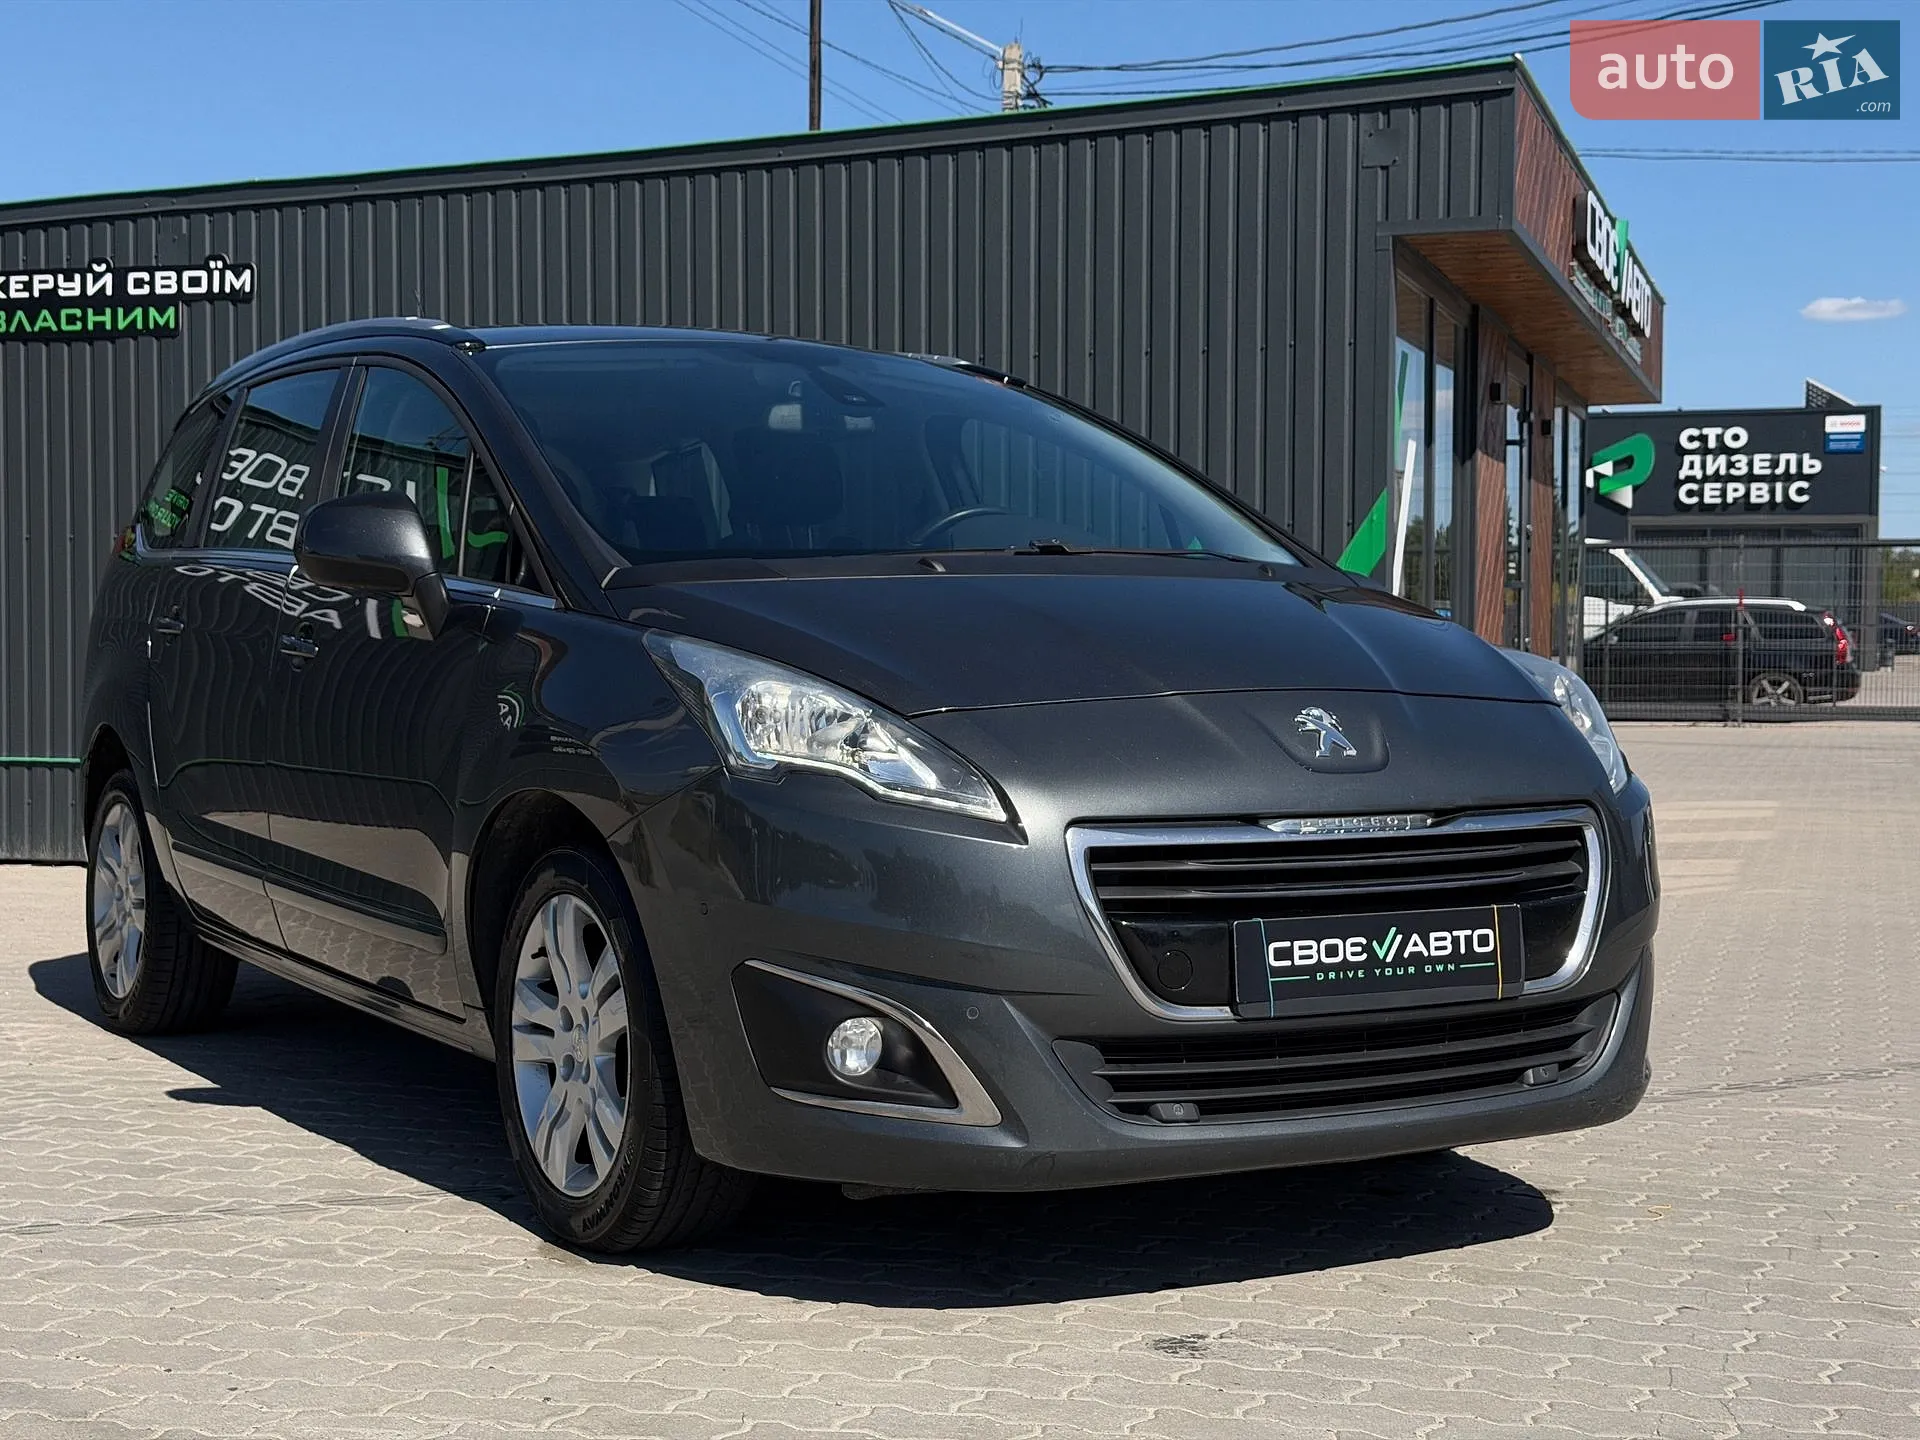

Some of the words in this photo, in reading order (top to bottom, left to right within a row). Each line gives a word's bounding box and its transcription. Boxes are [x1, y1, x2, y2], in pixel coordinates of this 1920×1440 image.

[0, 263, 113, 299] ЕРУЙ
[127, 260, 251, 296] СВОЇМ
[0, 305, 176, 333] ЛАСНИМ
[1679, 426, 1749, 450] СТО
[1678, 452, 1823, 480] ДИЗЕЛЬ
[1678, 480, 1811, 505] СЕРВІС
[1403, 928, 1495, 959] АВТО
[1316, 969, 1365, 981] DRIVE
[1374, 965, 1416, 977] YOUR
[1424, 962, 1456, 974] OWN
